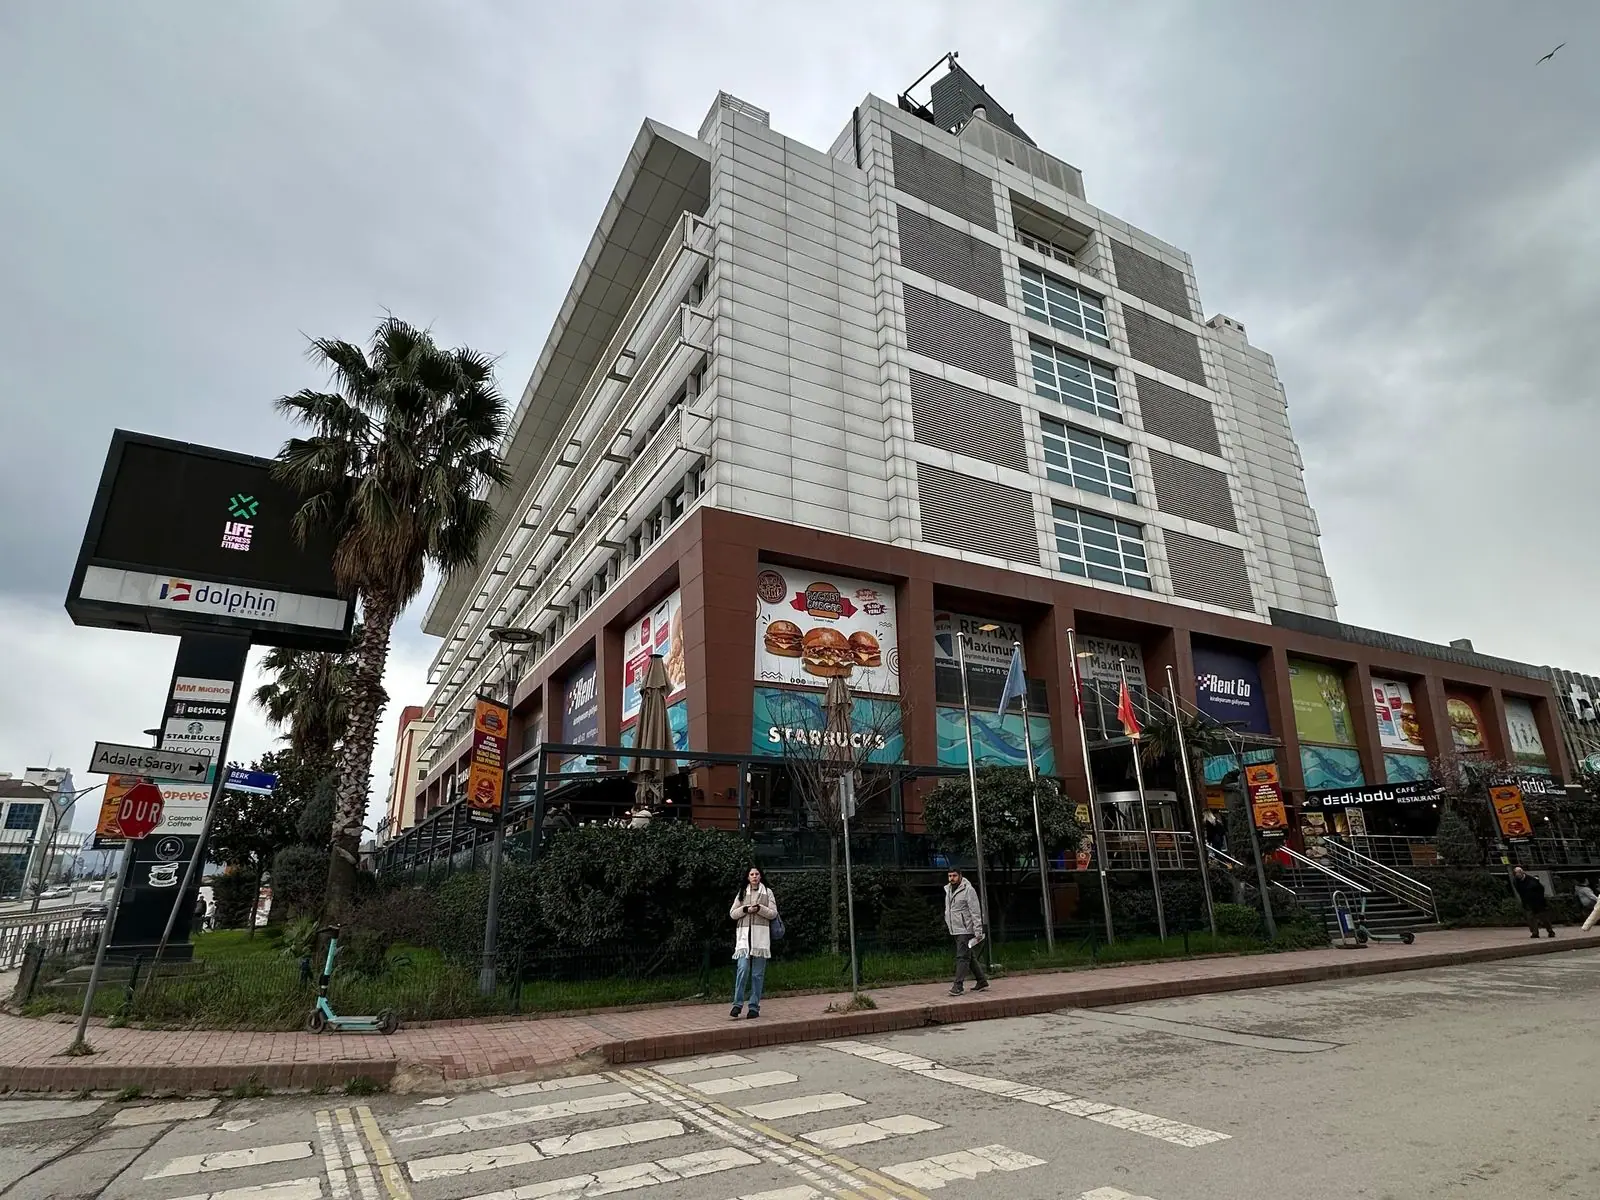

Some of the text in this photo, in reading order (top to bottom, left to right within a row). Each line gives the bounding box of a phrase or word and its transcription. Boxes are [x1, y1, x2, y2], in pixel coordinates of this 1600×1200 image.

[222, 534, 251, 544] EXPRESS
[221, 541, 250, 551] FITNESS
[195, 585, 275, 612] dolphin
[232, 608, 274, 617] center
[1087, 640, 1138, 660] RE/MAX
[175, 684, 196, 692] MM
[1210, 674, 1251, 697] Rent Go
[187, 706, 227, 715] BEŞİKTAŞ
[166, 733, 221, 741] STARBUCKS
[768, 726, 885, 750] STARBUCKS
[99, 751, 183, 774] Adalet Sarayı
[231, 771, 250, 780] BERK
[1395, 786, 1416, 794] CAFE
[1397, 794, 1441, 804] RESTAURANT
[121, 799, 160, 823] DUR
